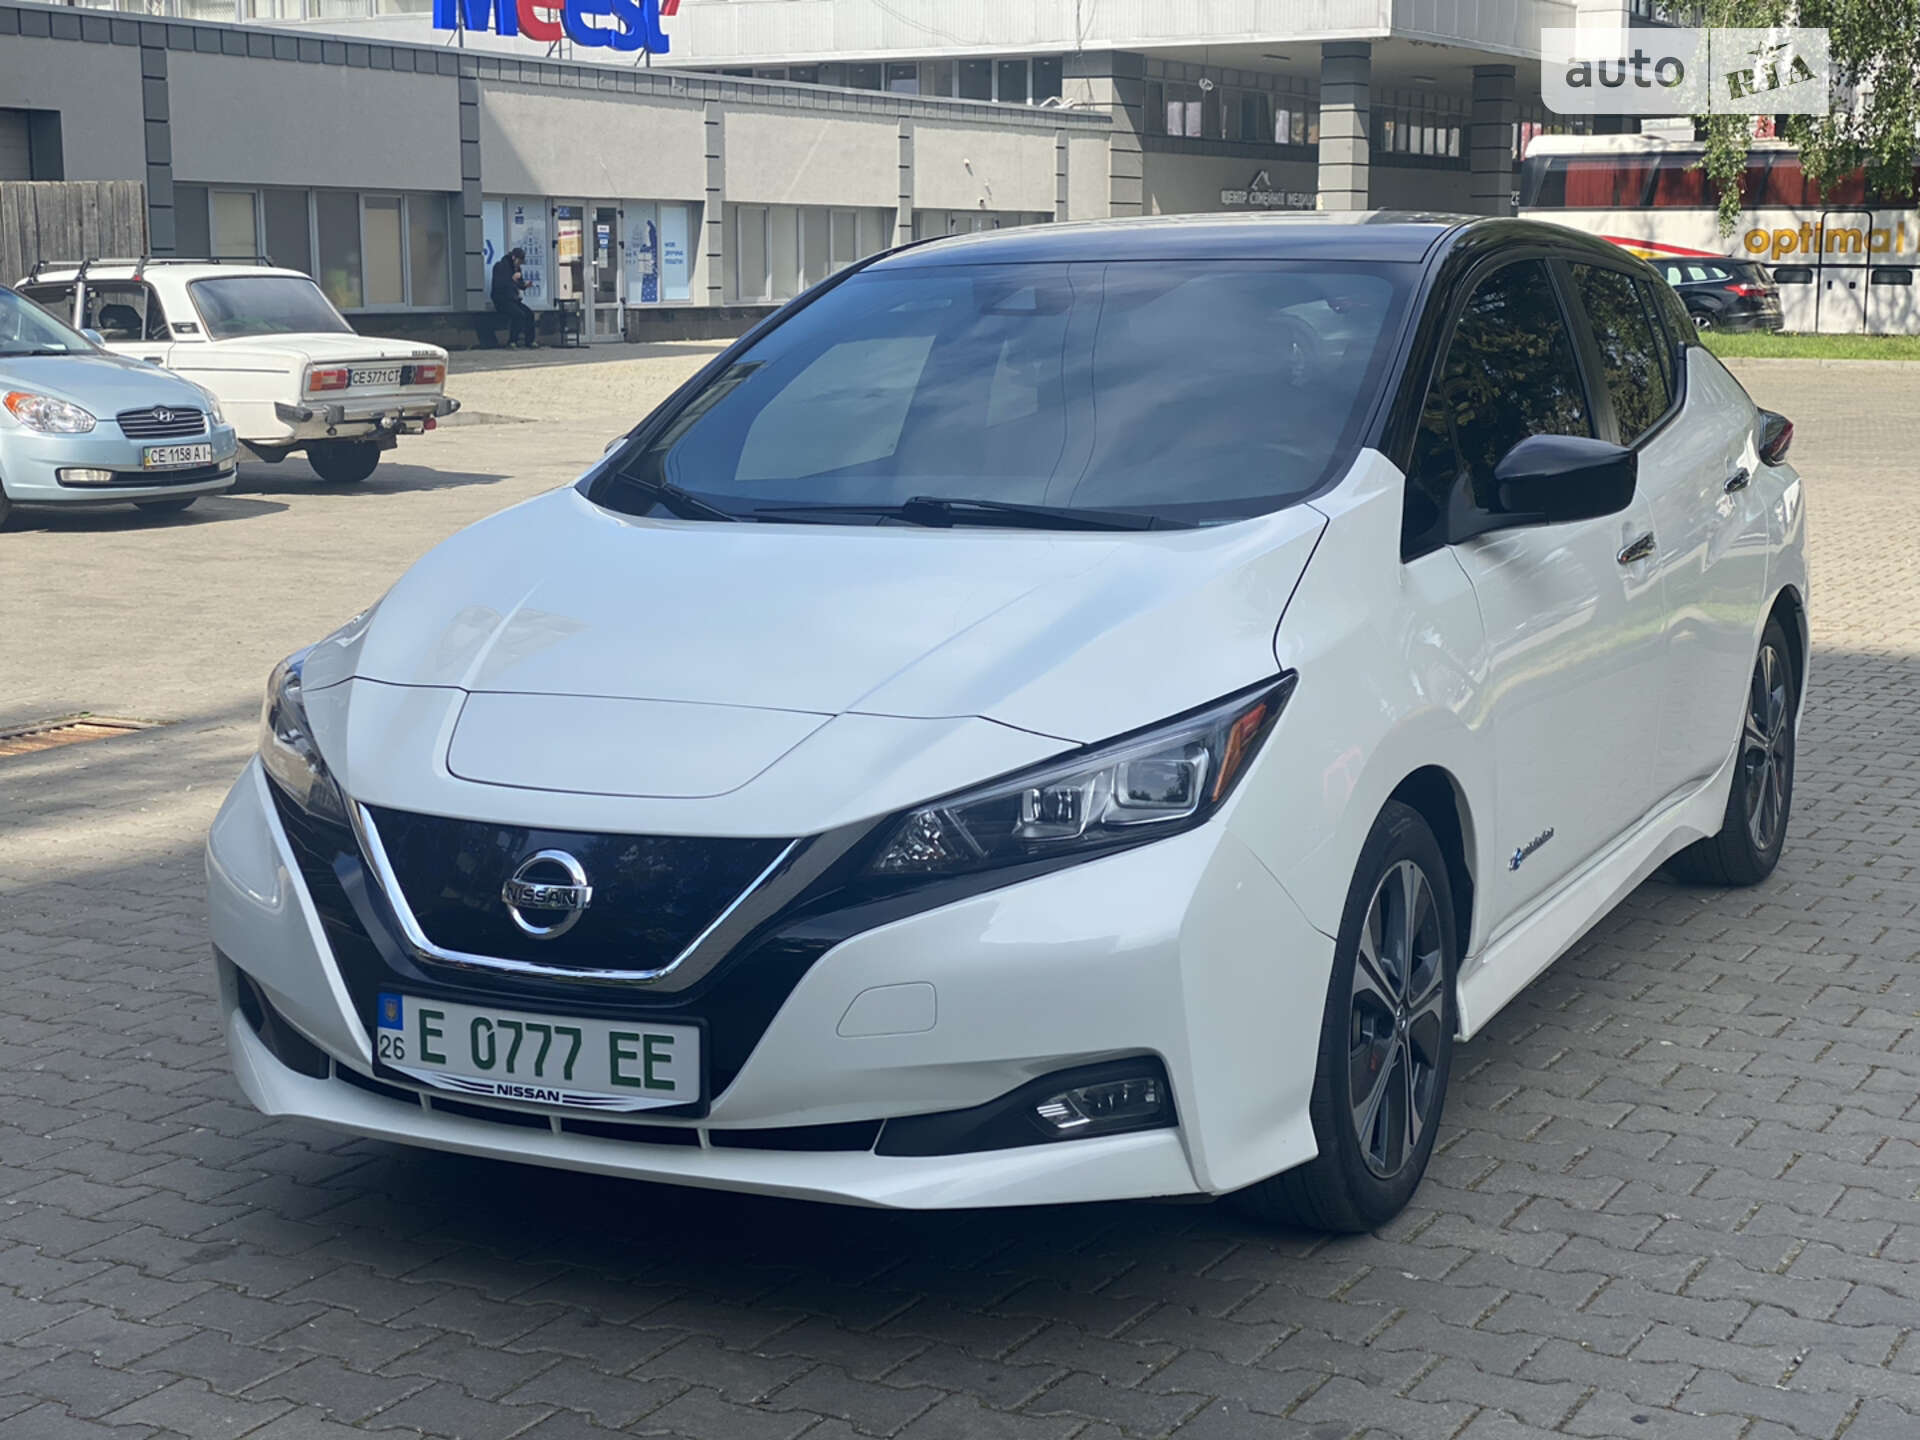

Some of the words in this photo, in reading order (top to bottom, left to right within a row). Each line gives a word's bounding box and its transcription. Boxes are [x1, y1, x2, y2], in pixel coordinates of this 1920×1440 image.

[1744, 221, 1905, 260] optimal
[352, 371, 366, 384] CE
[388, 370, 401, 382] CT
[151, 449, 167, 464] CE
[168, 447, 192, 462] 1158
[508, 885, 577, 905] NISSAN
[379, 1035, 405, 1060] 26
[418, 1009, 446, 1064] E
[470, 1017, 582, 1080] 0777
[609, 1031, 675, 1090] EE
[496, 1084, 561, 1103] NISSAN
